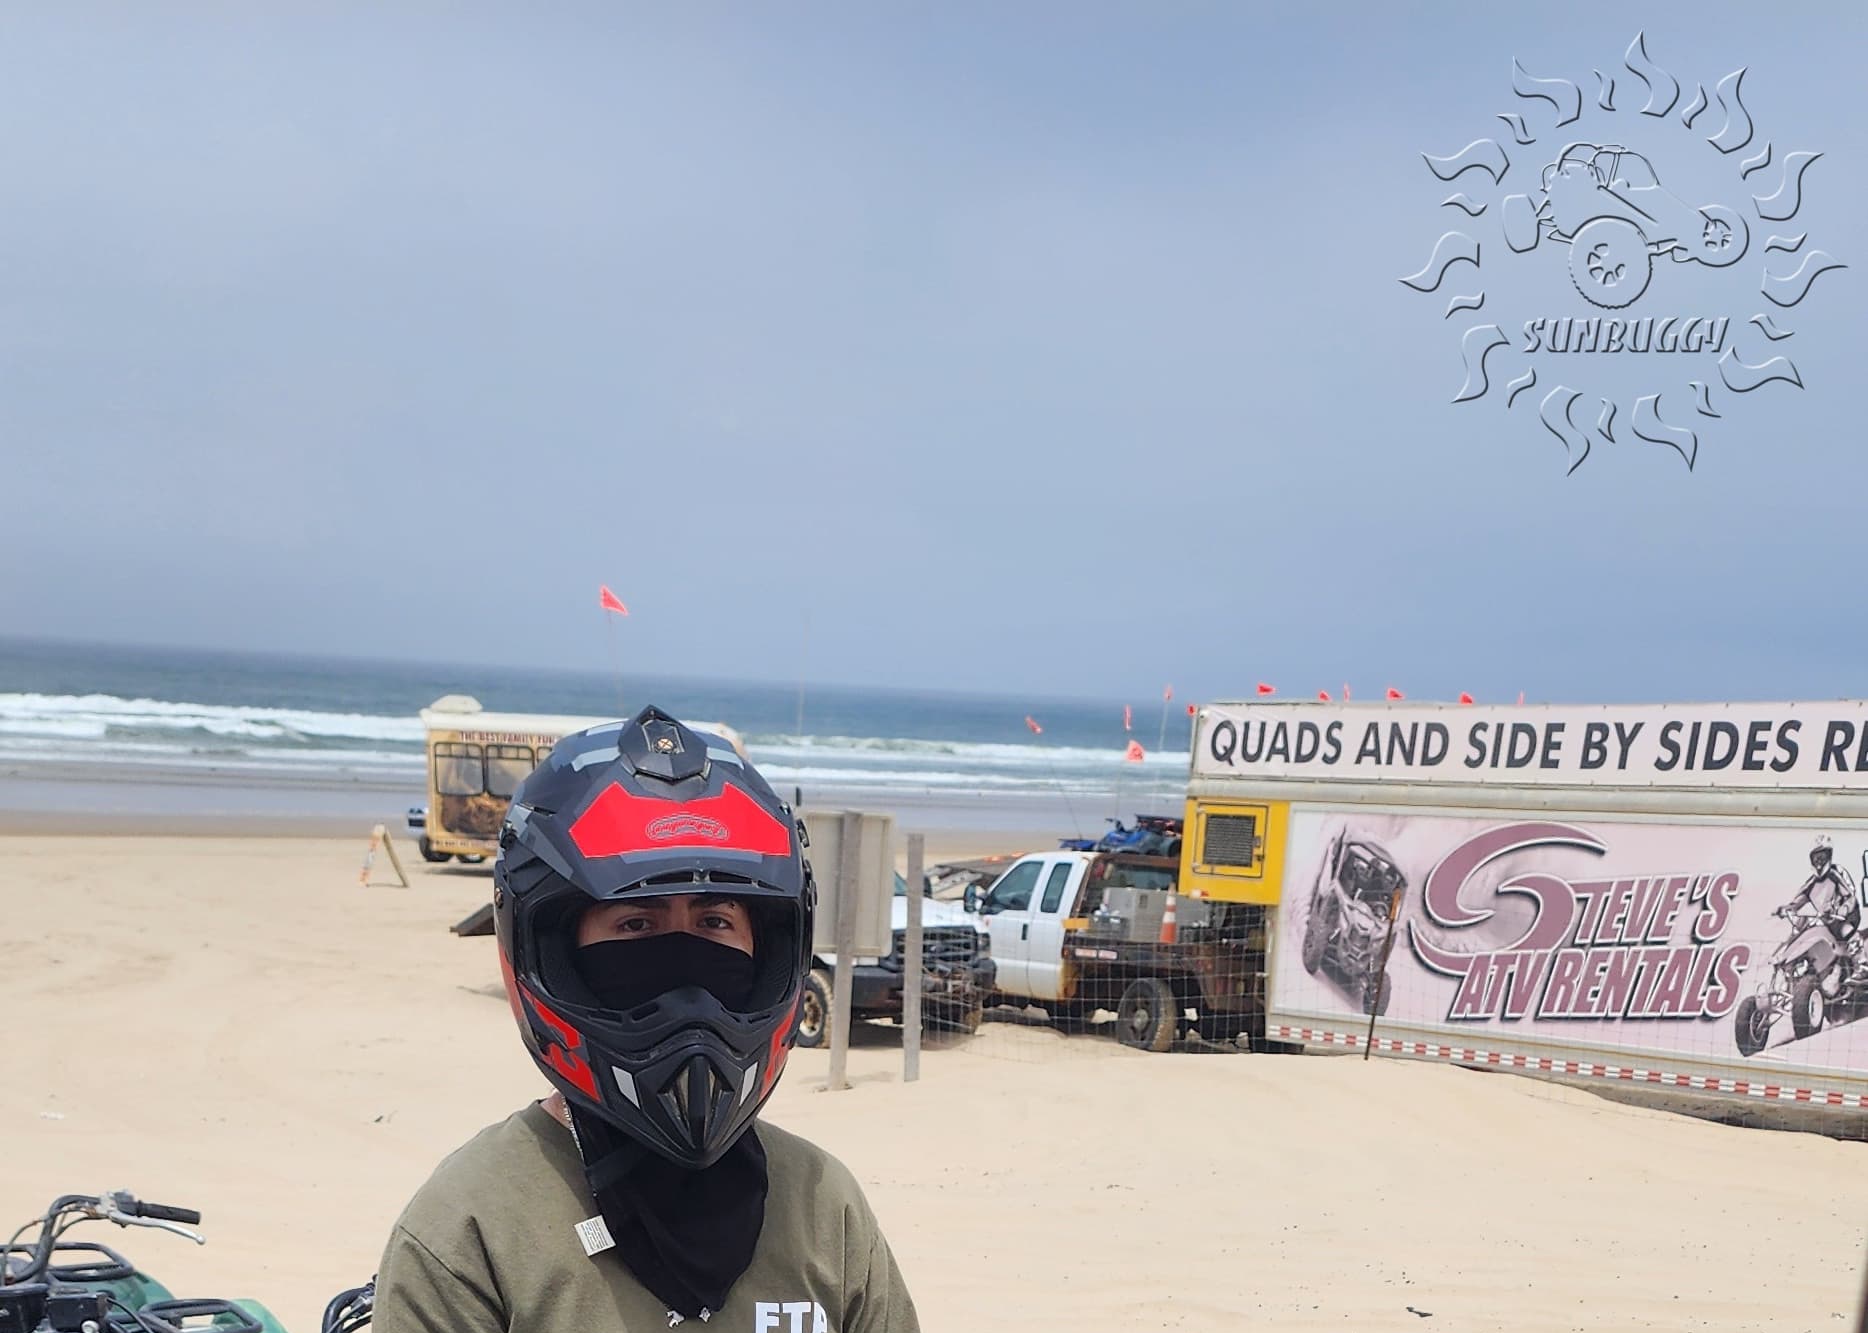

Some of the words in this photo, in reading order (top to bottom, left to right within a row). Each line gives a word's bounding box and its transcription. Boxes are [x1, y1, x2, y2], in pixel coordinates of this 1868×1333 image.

[1210, 719, 1344, 766] QUADS
[1354, 721, 1450, 766] AND
[1464, 722, 1566, 769] SIDE
[1579, 721, 1645, 770] BY
[1654, 719, 1802, 773] SIDES
[1410, 820, 1741, 978] STEVE'S
[1448, 948, 1550, 1020] ATV
[1536, 944, 1752, 1020] RENTALS
